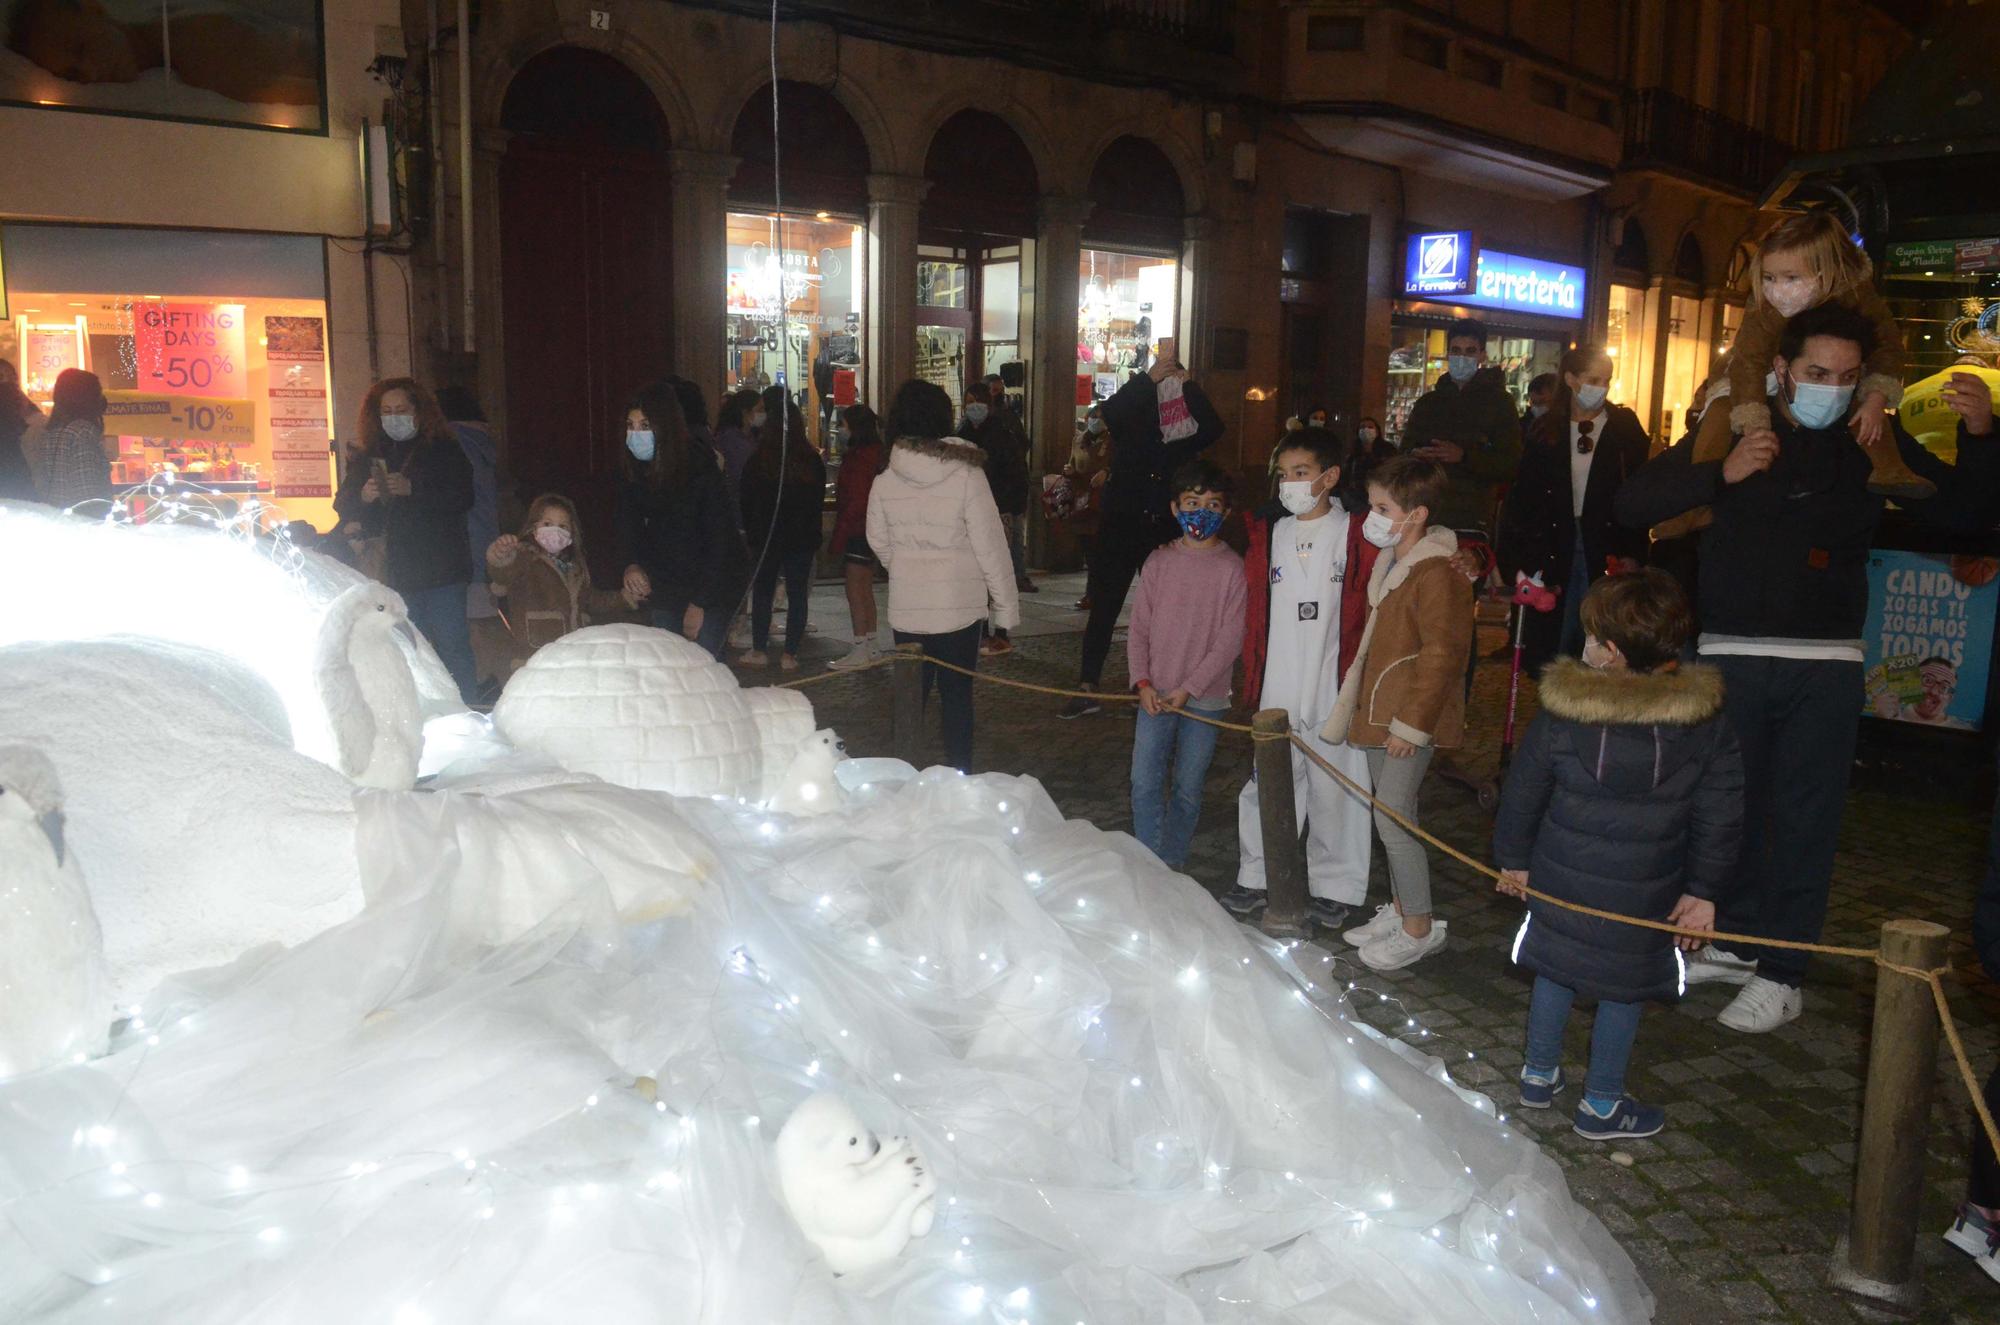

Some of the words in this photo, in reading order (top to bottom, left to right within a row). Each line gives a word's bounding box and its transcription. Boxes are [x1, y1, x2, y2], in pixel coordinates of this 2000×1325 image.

[597, 13, 604, 28] 2
[1405, 281, 1417, 292] La
[1418, 278, 1467, 291] Ferretería
[144, 310, 234, 329] GIFTING
[165, 330, 216, 346] DAYS
[152, 355, 233, 388] -50%
[106, 403, 137, 416] EMATE
[171, 404, 234, 432] -10%
[1886, 569, 1971, 601] CANDO
[1884, 595, 1938, 616] XOGAS
[1882, 613, 1968, 639] XOGAMOS
[1880, 633, 1964, 668] TODOS
[1619, 1114, 1639, 1131] N
